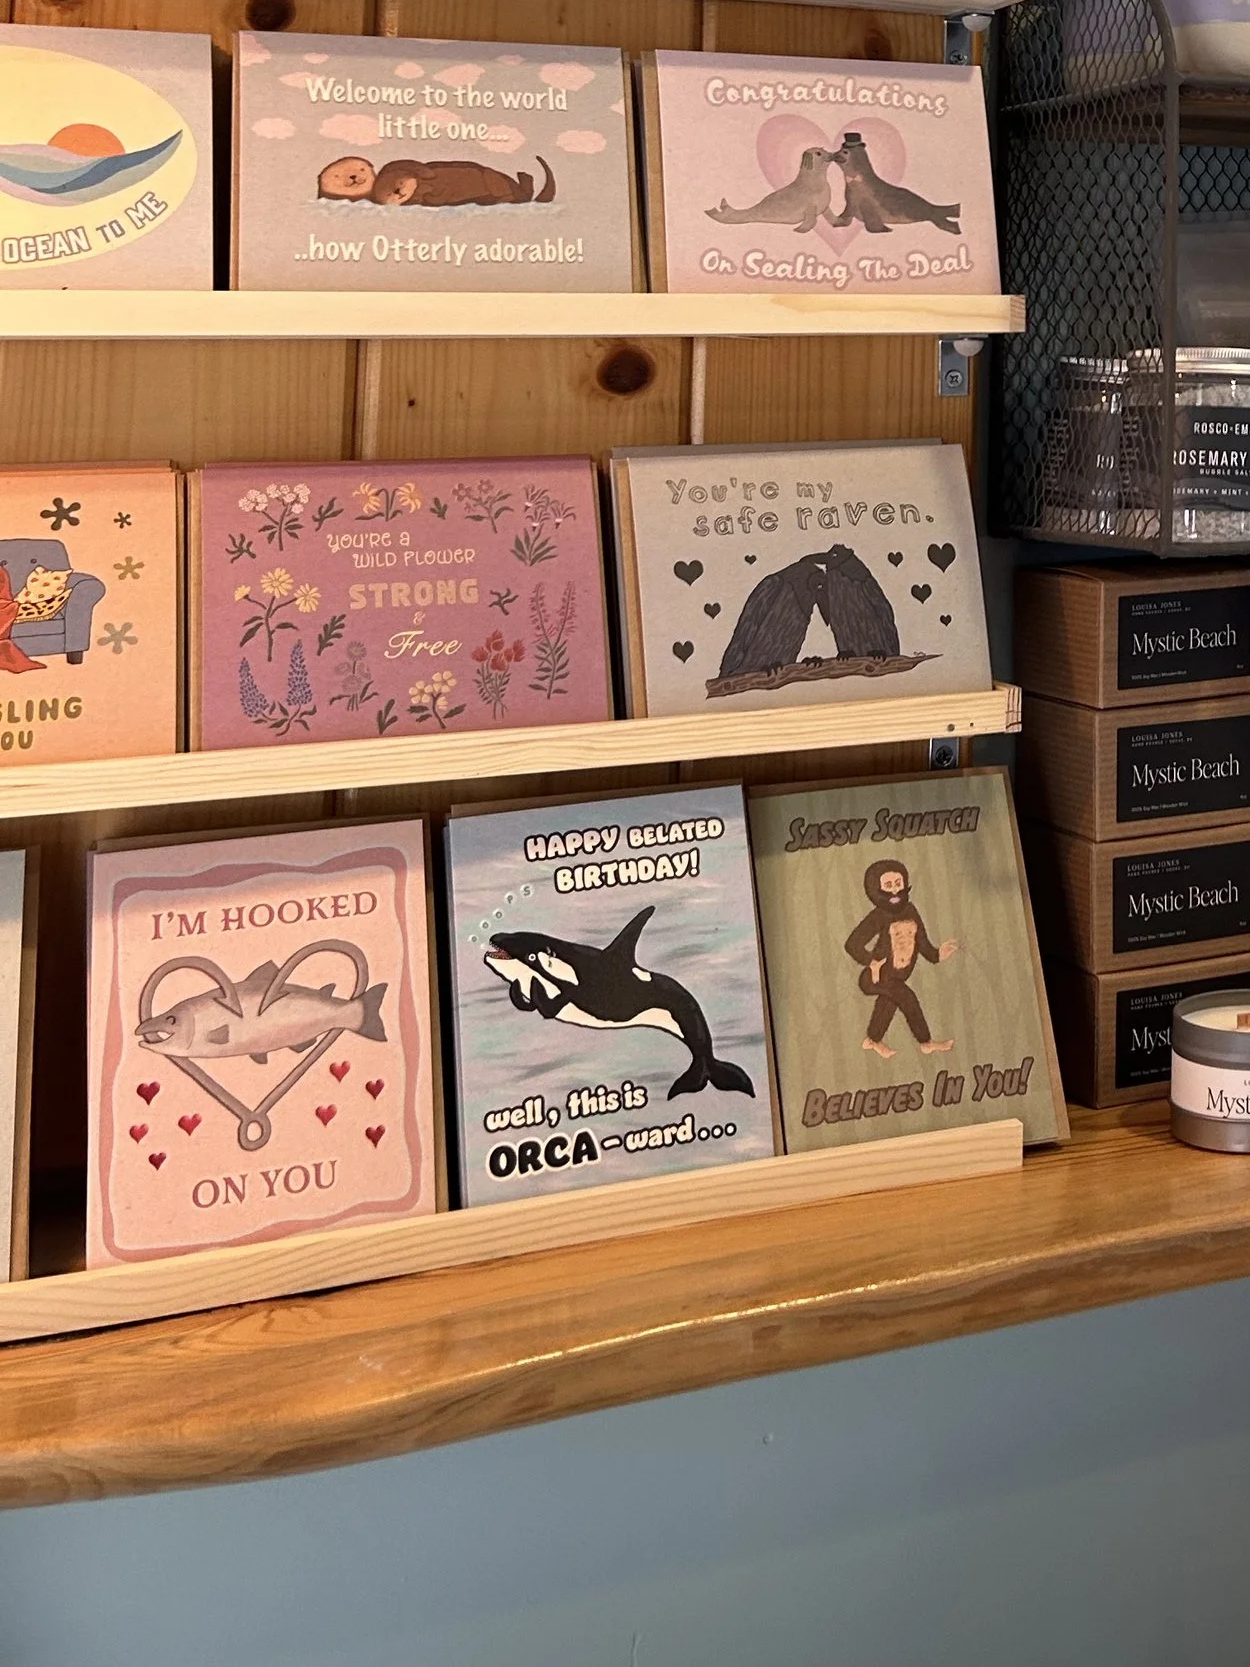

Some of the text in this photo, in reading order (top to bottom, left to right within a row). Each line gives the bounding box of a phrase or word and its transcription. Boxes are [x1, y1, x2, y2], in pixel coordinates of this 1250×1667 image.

[305, 77, 568, 110] Welcome to the world
[706, 78, 949, 117] Congratulations
[378, 113, 440, 139] little
[2, 191, 168, 264] OCEAN TO ME
[372, 235, 467, 266] Otterly
[474, 237, 584, 264] adorable!
[702, 247, 971, 287] On Sealing The Deal
[666, 477, 834, 505] You're my
[692, 501, 934, 537] safe raven.
[404, 548, 476, 566] FLOWER
[349, 578, 480, 610] STRONG
[384, 630, 463, 659] Free
[1132, 623, 1237, 660] Mystic Beach
[1132, 752, 1240, 792] Mystic Beach
[524, 817, 725, 862] HAPPY BELATED
[554, 848, 700, 894] BIRTHDAY!
[151, 891, 378, 941] I'M HOOKED
[1127, 880, 1239, 921] Mystic Beach
[483, 1081, 648, 1132] well, this is
[191, 1160, 339, 1208] ON YOU
